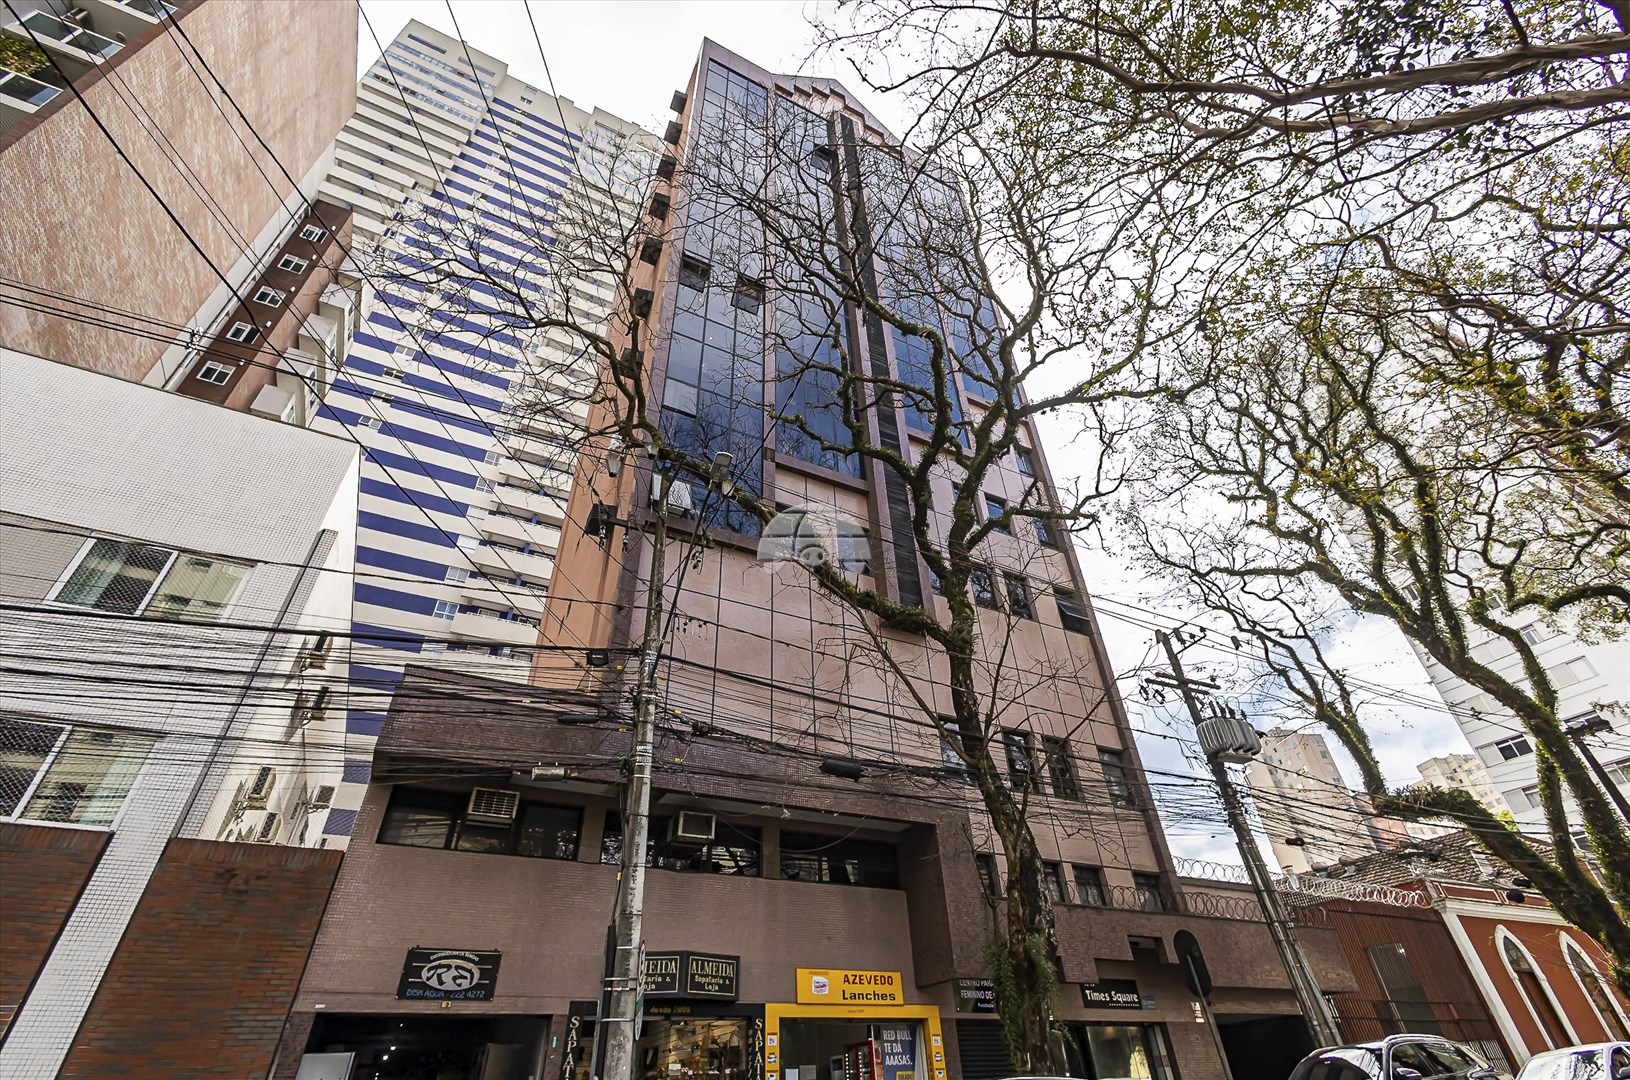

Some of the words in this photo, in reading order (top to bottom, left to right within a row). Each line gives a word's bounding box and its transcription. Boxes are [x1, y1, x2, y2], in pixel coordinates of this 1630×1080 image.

[645, 959, 676, 974] EIDA
[691, 960, 734, 977] ALMEIDA
[695, 974, 723, 984] Sapataria
[843, 974, 894, 986] AZEVEDO
[406, 988, 424, 996] DISK
[643, 982, 656, 991] oja
[705, 983, 719, 991] Loja
[842, 989, 896, 1001] Lanches
[1085, 989, 1110, 1001] Times
[1111, 991, 1139, 1003] Square
[883, 1030, 896, 1041] RED
[896, 1030, 912, 1041] BULL
[562, 1015, 580, 1080] SAPAT
[884, 1043, 892, 1053] TE
[892, 1040, 903, 1053] DÁ
[885, 1055, 913, 1066] AAASAS.
